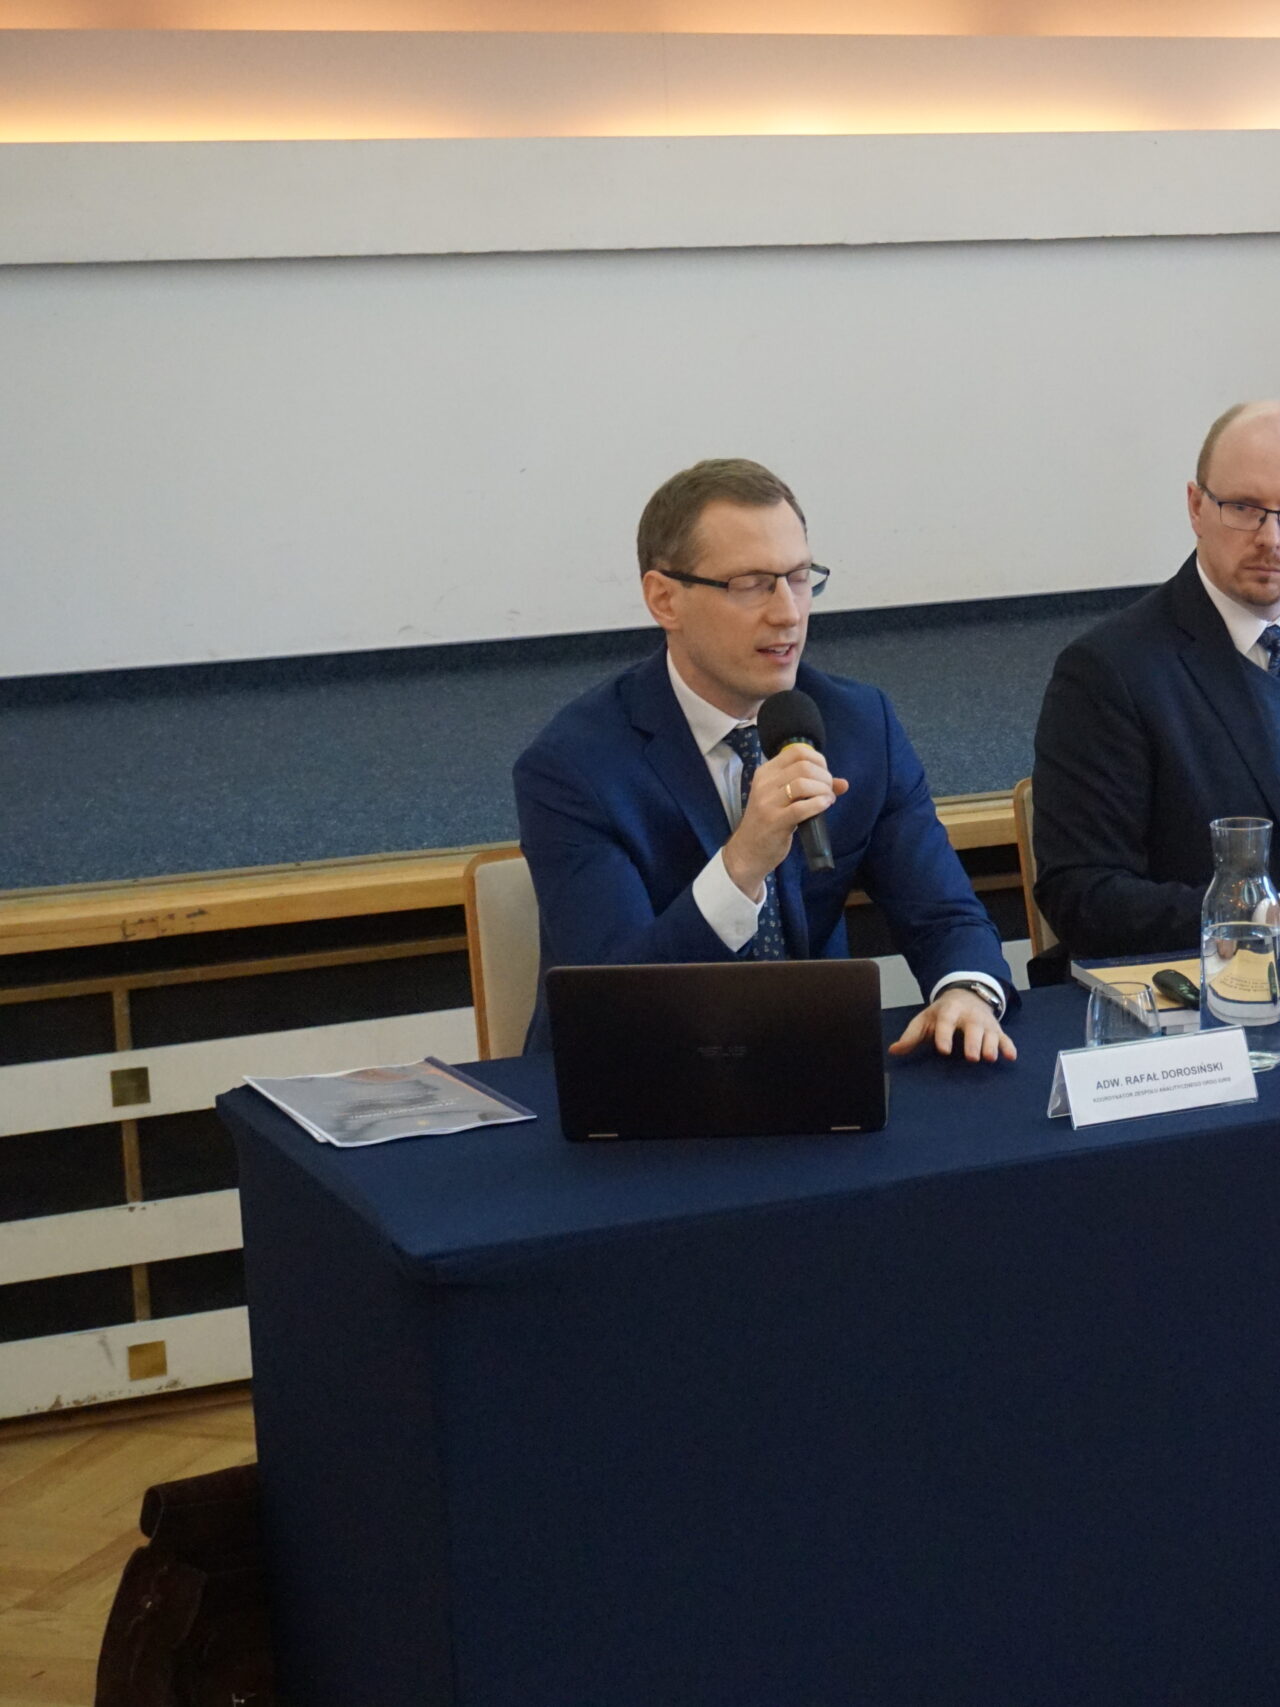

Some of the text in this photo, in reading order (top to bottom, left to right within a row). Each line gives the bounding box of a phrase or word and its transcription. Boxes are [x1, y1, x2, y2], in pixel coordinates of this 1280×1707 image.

[1096, 1061, 1224, 1090] ADW. RAFAŁ DOROSIŃSKI
